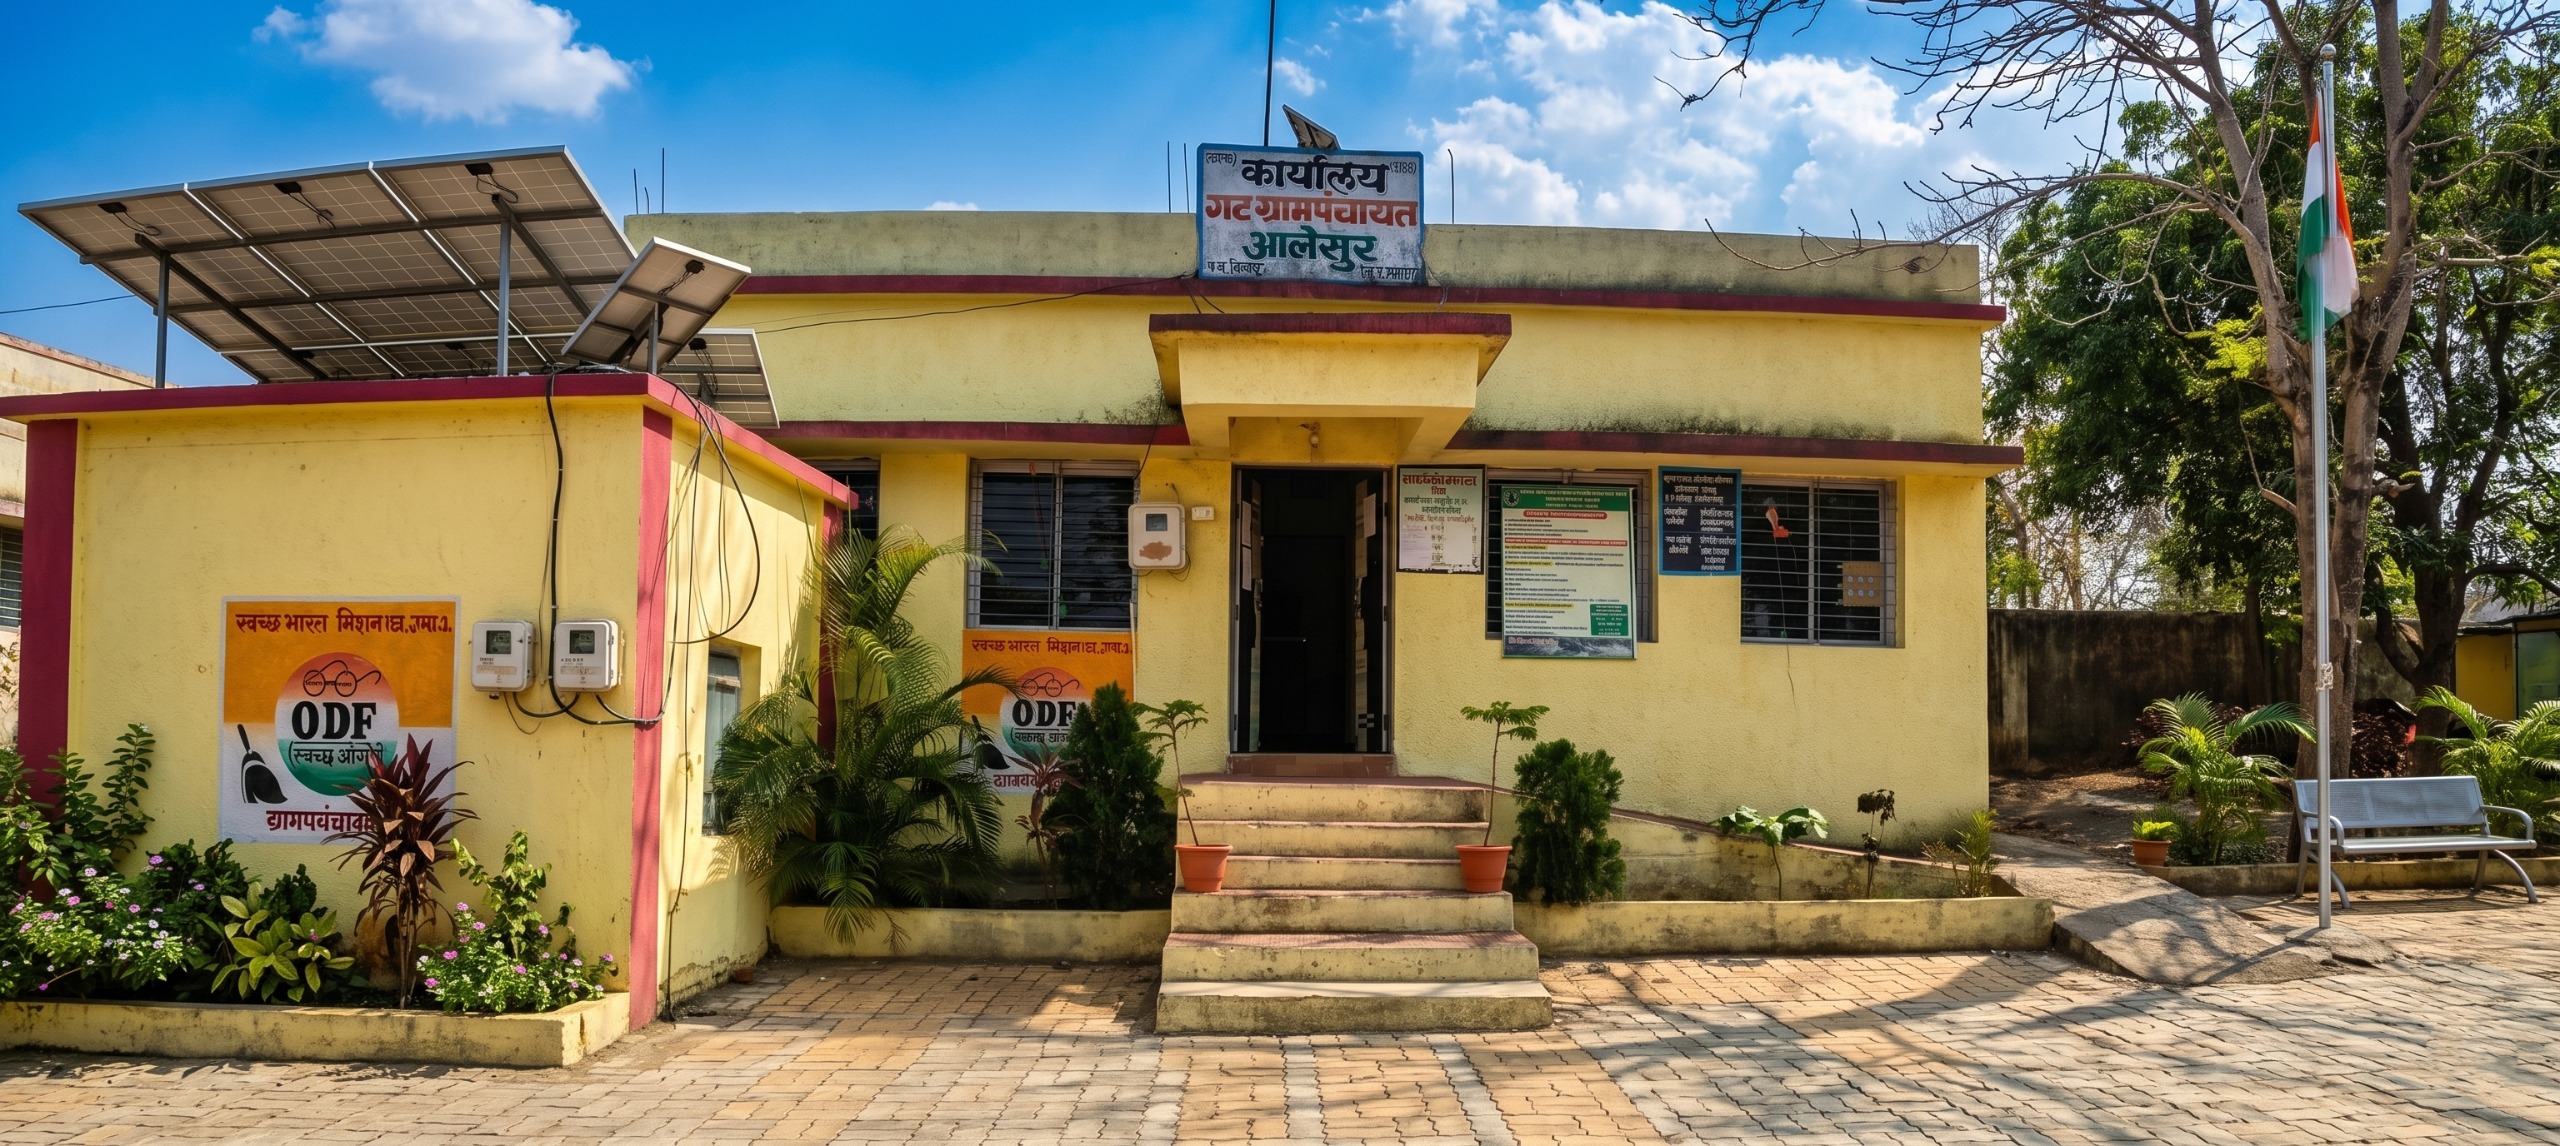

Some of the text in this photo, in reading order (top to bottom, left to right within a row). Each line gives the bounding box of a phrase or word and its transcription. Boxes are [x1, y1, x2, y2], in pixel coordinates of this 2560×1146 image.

[1242, 155, 1390, 195] कार्यालय
[1205, 191, 1418, 227] गट ग्रामपंचायत
[1242, 225, 1378, 272] आलेसुर
[291, 700, 377, 740] ODF
[1012, 699, 1077, 727] ODF
